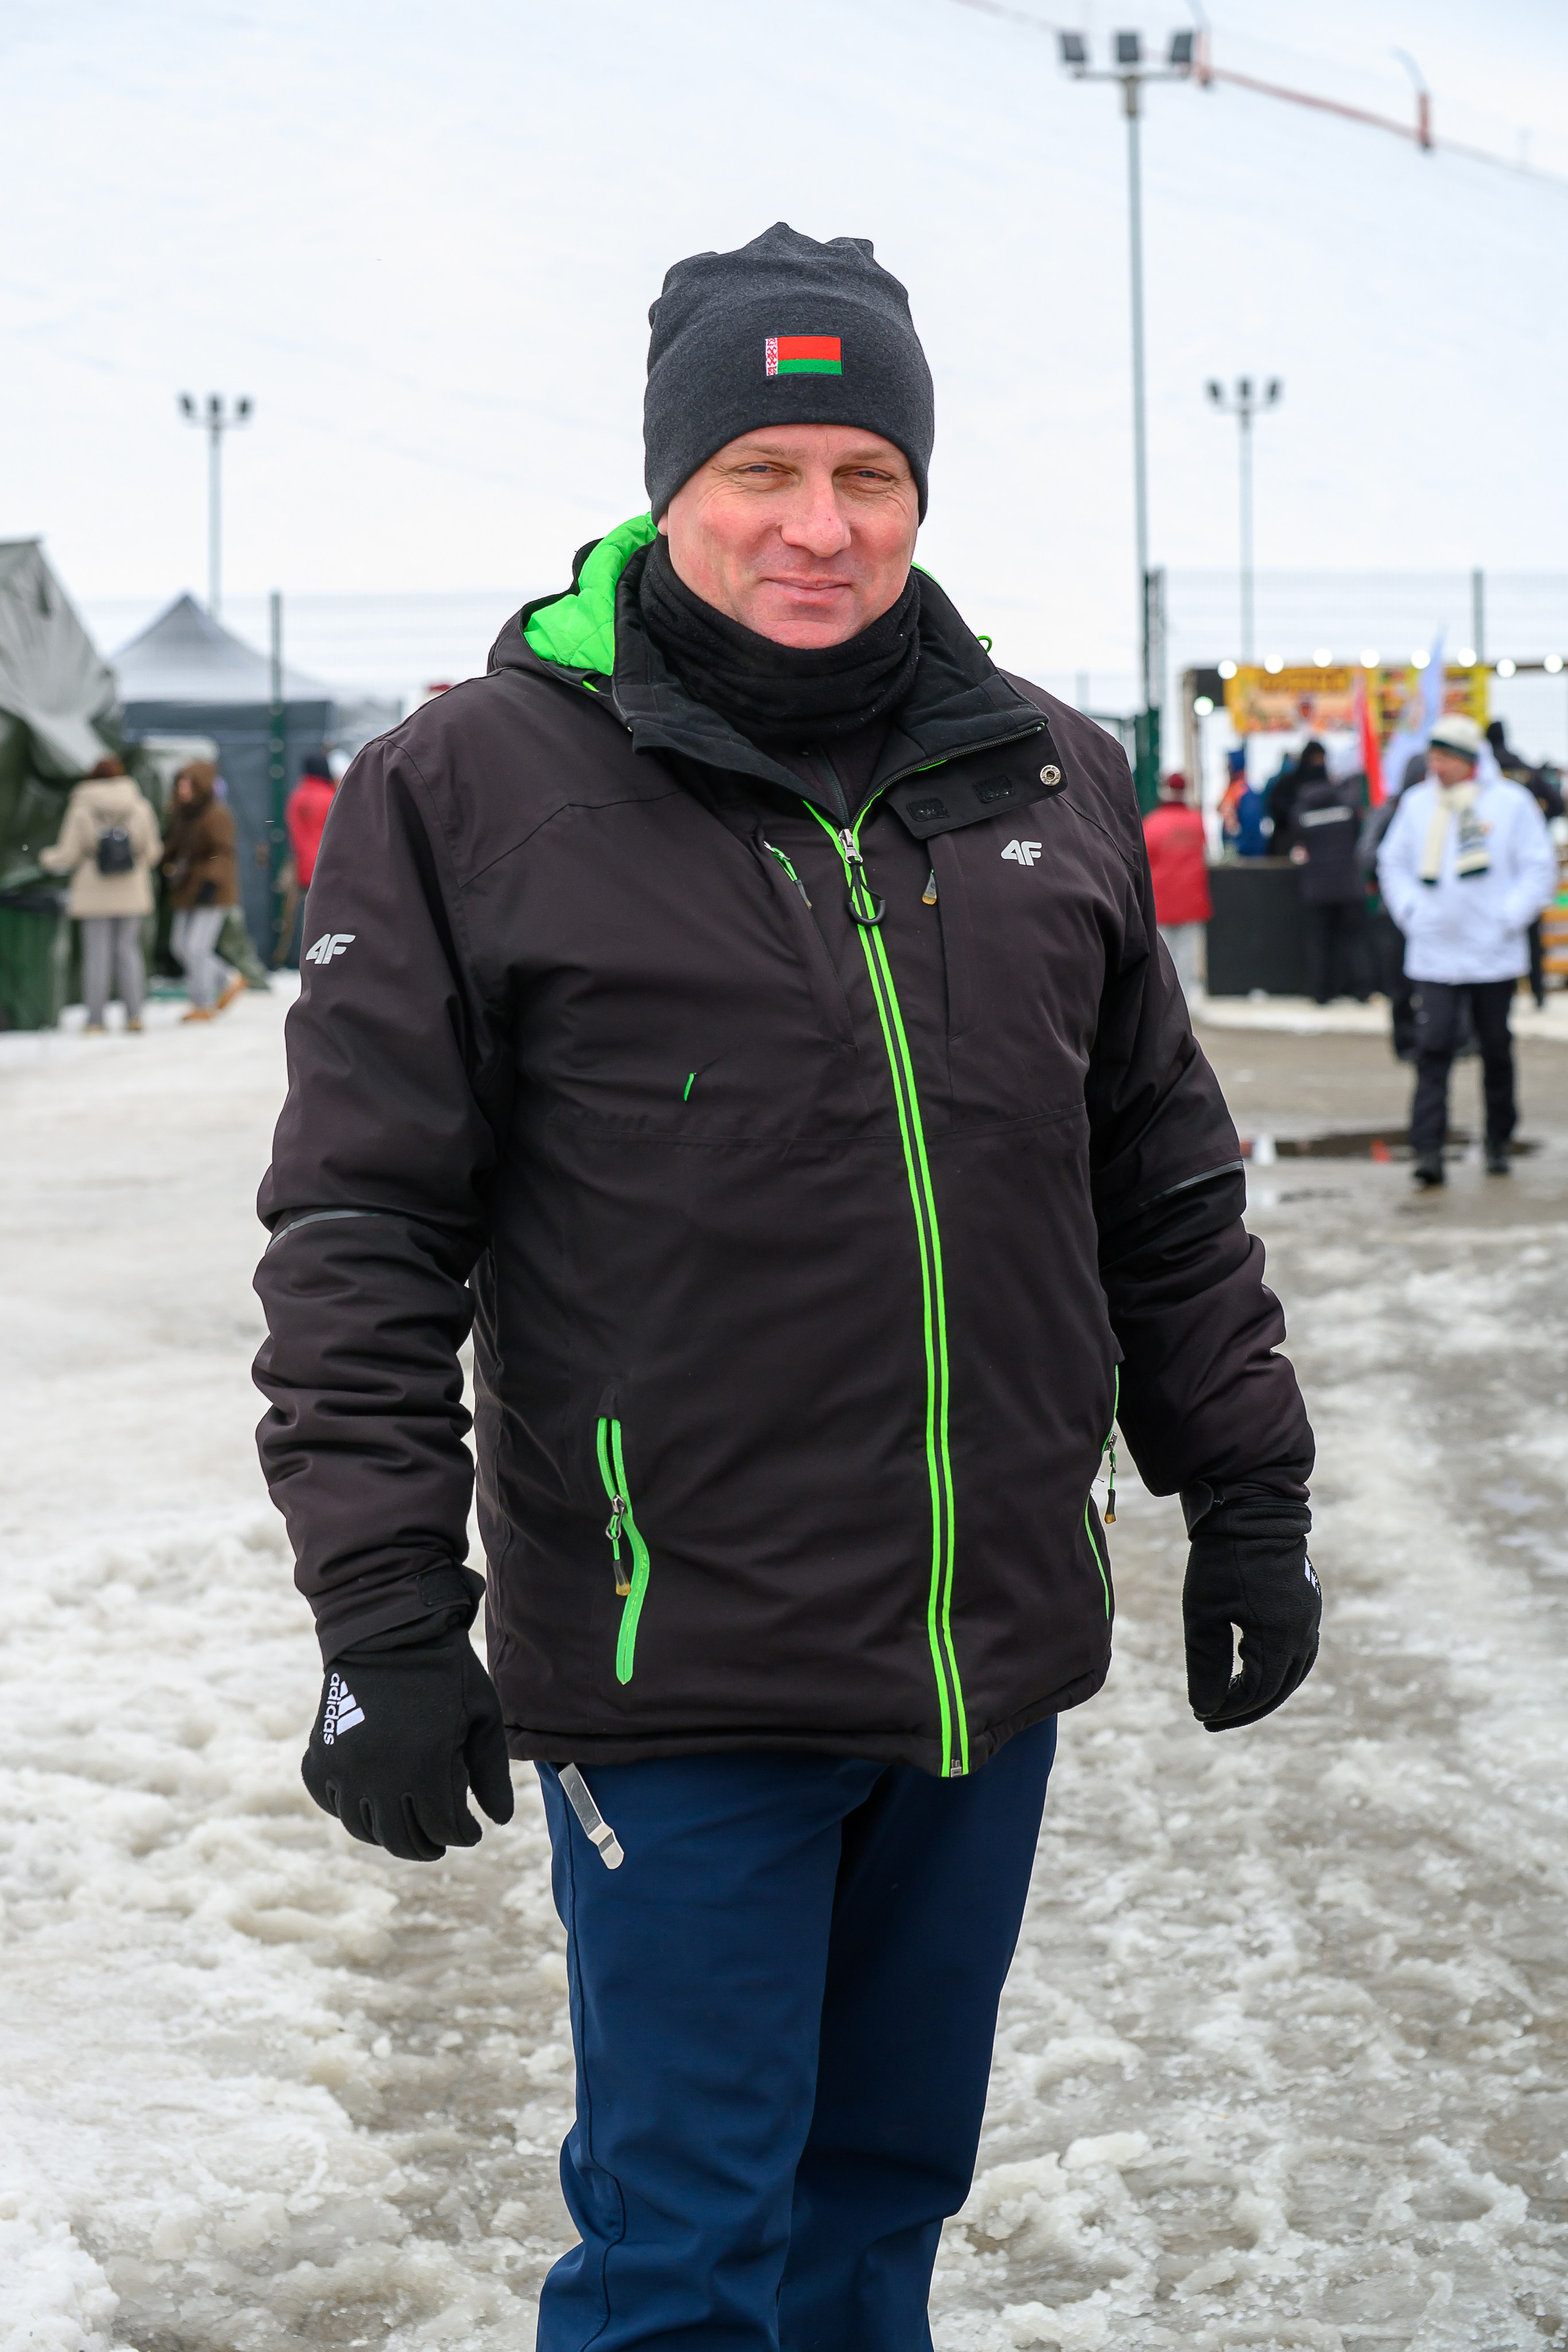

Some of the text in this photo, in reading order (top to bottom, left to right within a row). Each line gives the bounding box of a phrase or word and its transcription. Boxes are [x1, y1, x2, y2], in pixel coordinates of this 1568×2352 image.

[1001, 840, 1042, 866] 4F
[305, 933, 356, 965] 4F
[323, 1673, 342, 1745] adidas
